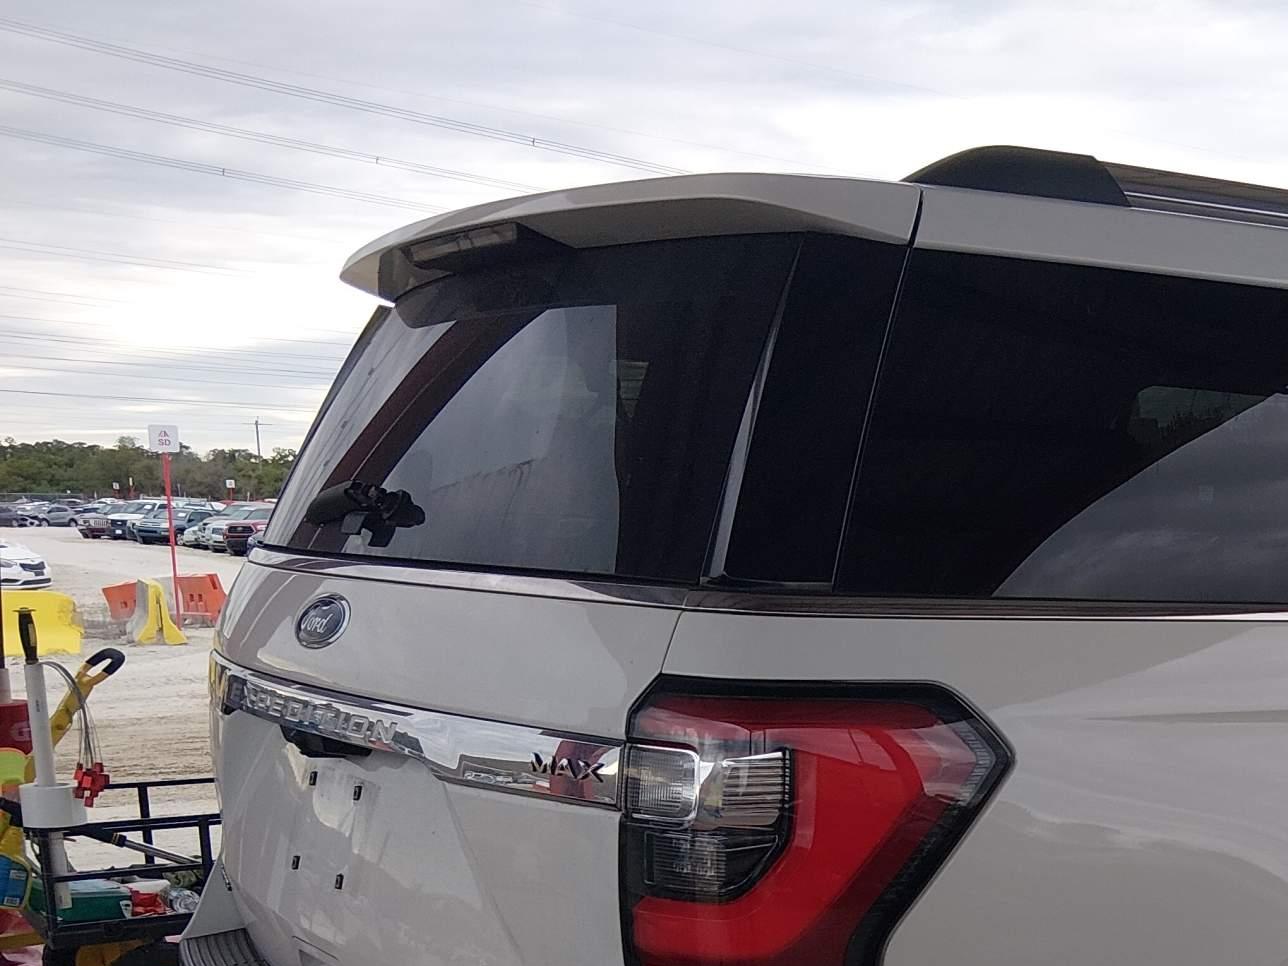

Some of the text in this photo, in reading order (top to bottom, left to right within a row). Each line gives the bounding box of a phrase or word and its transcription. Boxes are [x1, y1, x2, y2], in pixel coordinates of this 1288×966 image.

[301, 611, 334, 633] Ford
[230, 680, 398, 745] EXPEDITION
[530, 751, 605, 783] MAX
